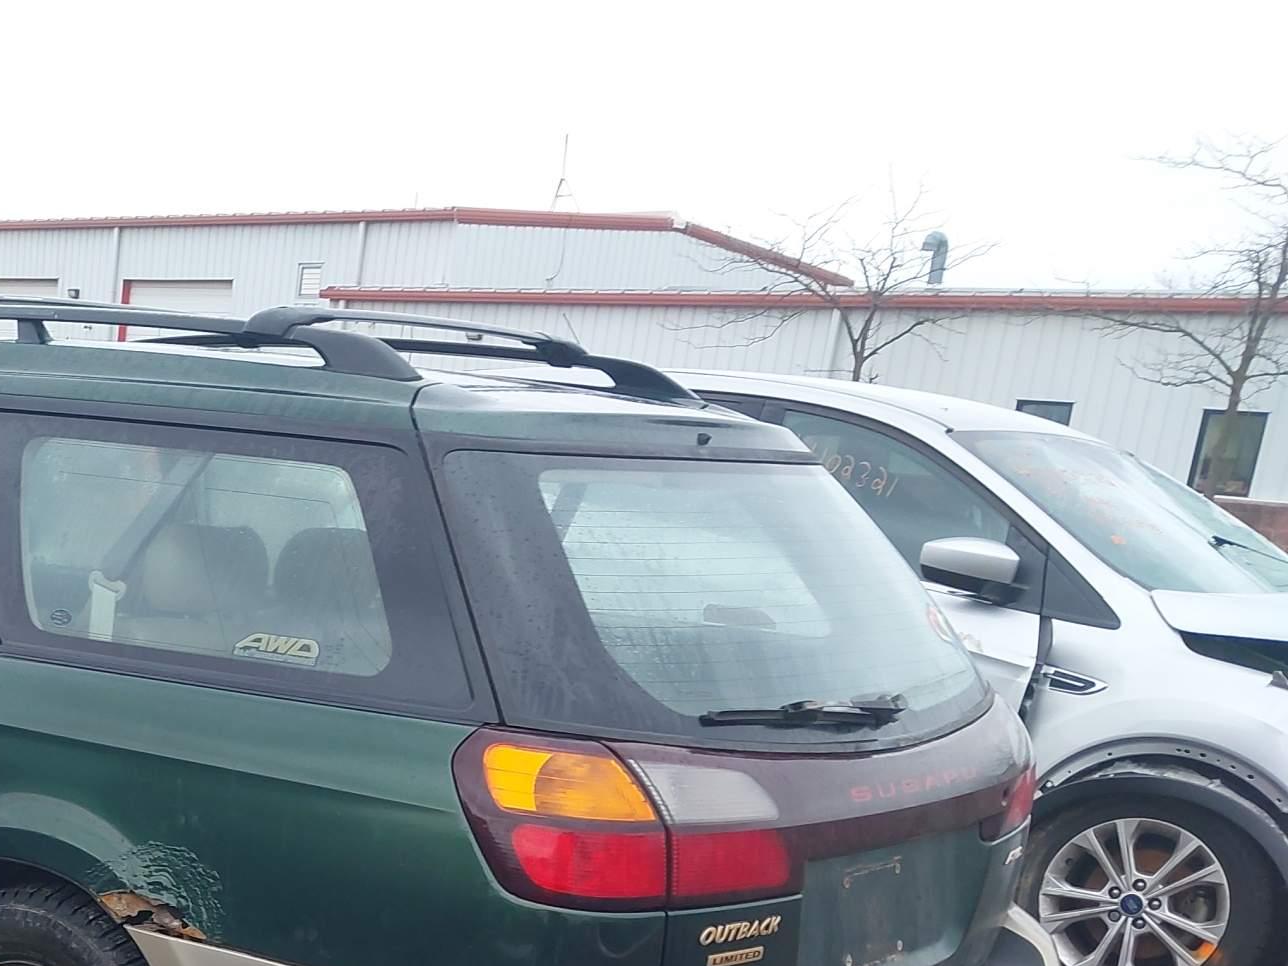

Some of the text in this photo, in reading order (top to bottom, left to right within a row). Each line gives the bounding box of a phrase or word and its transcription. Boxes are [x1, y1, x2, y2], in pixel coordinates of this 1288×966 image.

[235, 633, 319, 658] AWD
[850, 767, 978, 802] SUBARU
[699, 915, 782, 946] OUTBACK
[712, 950, 761, 966] LIMITED
